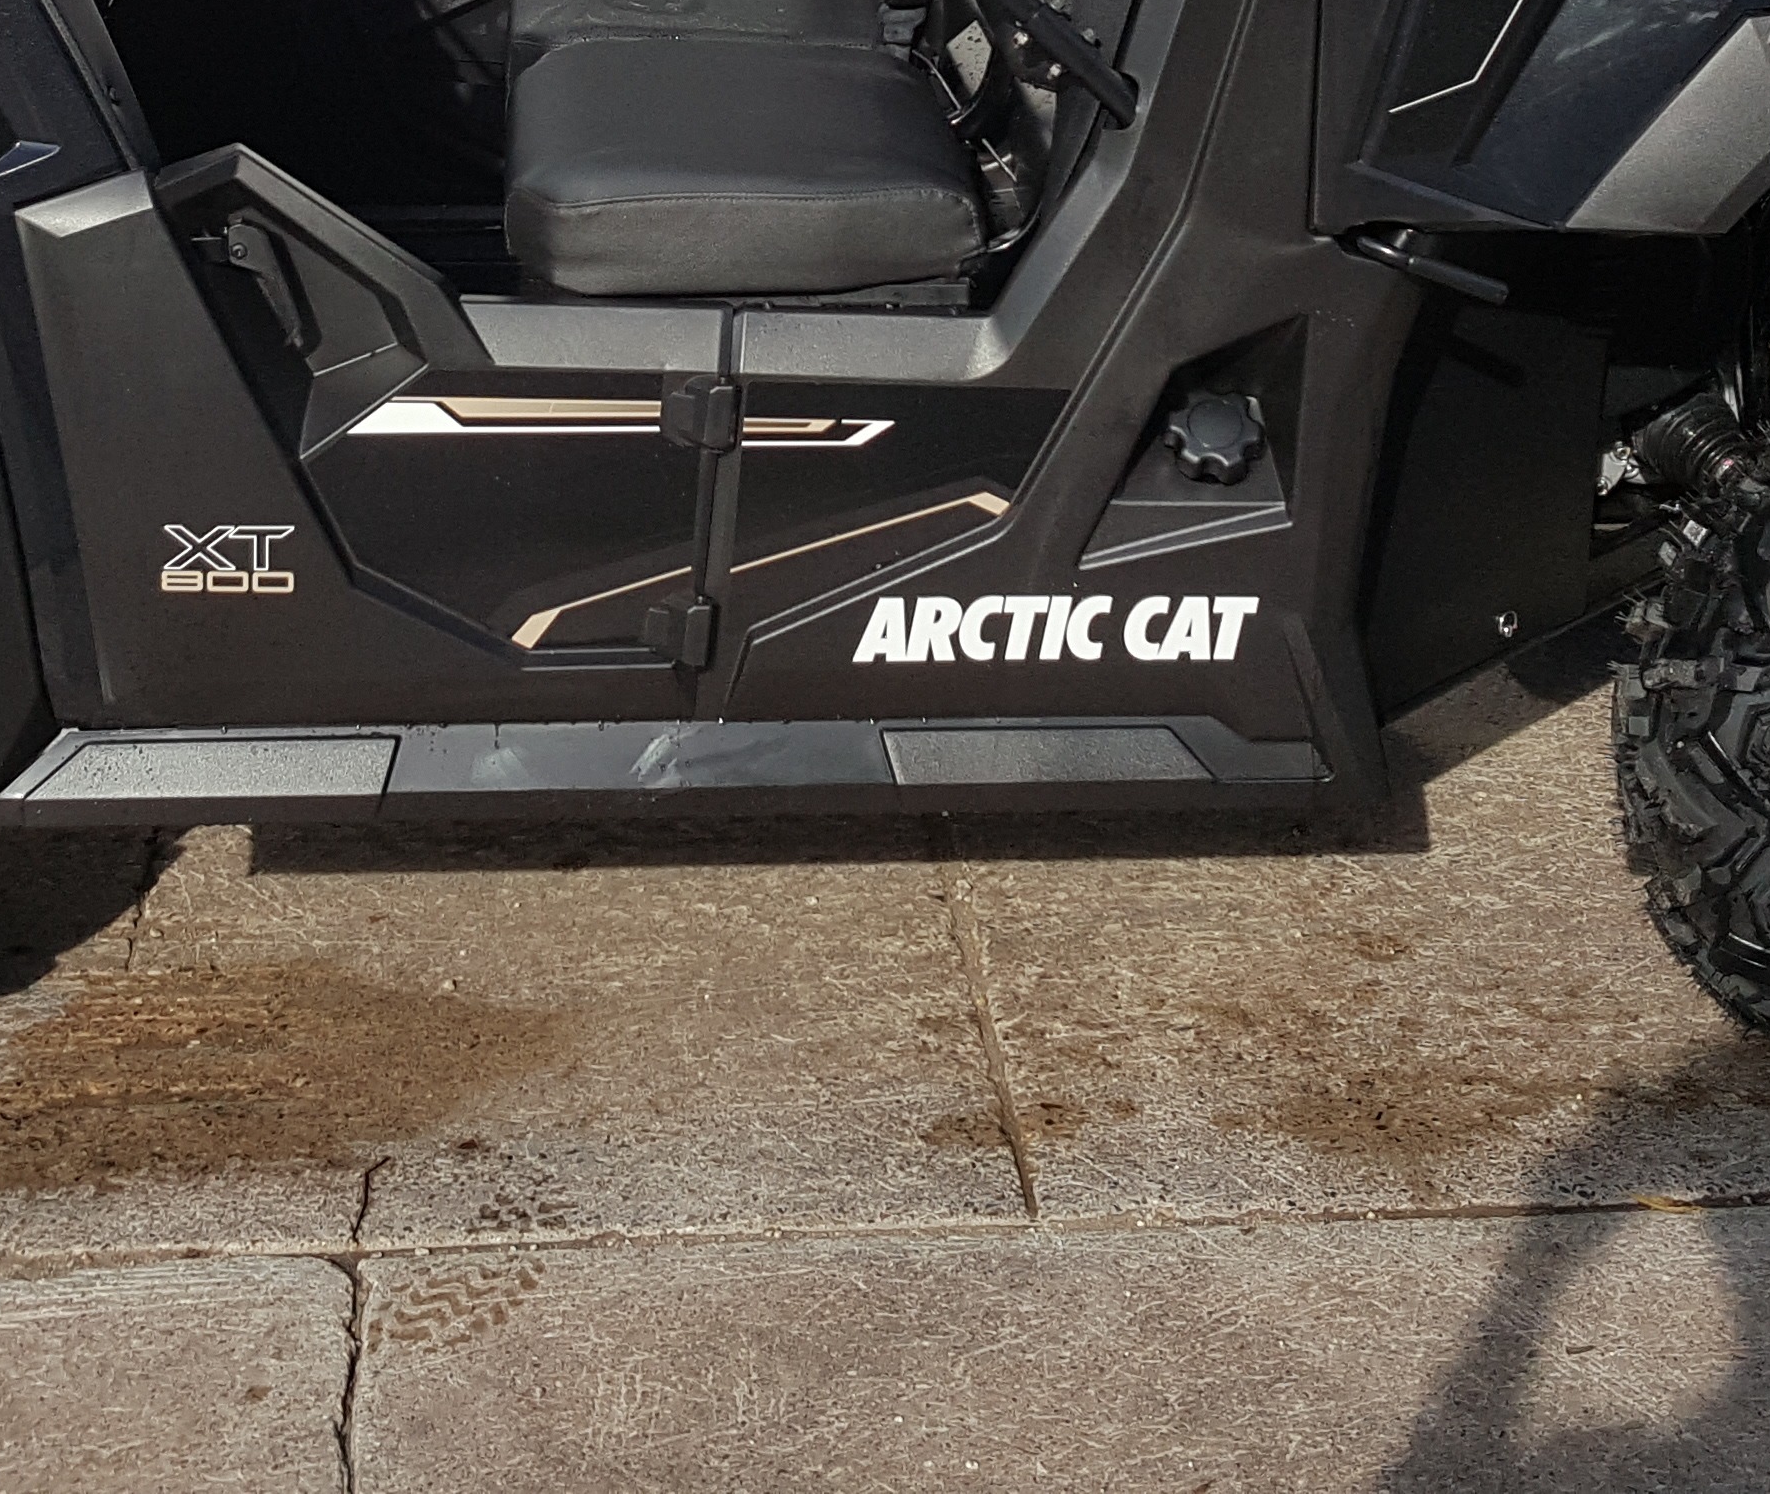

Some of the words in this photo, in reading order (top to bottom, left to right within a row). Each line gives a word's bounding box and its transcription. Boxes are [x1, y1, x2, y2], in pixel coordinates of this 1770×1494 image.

[163, 524, 295, 571] XT
[161, 570, 295, 594] 800
[852, 595, 1113, 663] ARCTIC
[1123, 595, 1260, 661] CAT
